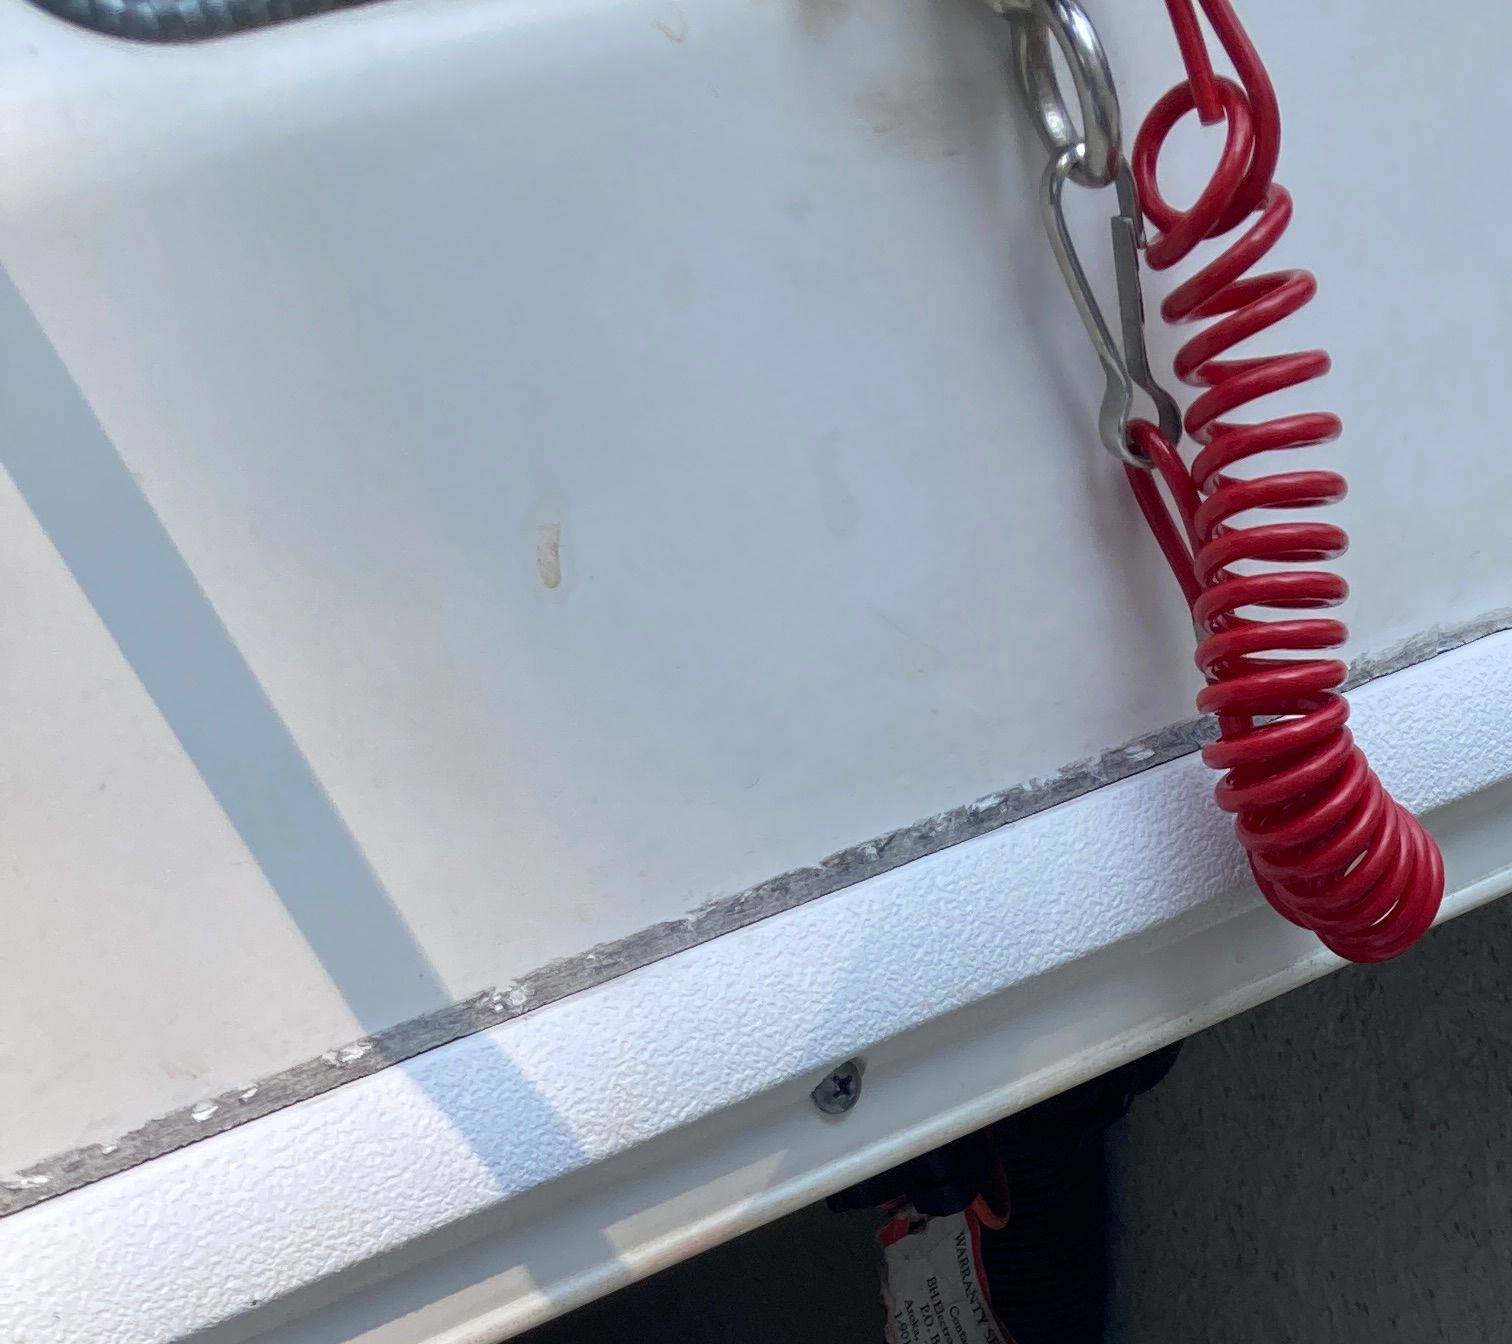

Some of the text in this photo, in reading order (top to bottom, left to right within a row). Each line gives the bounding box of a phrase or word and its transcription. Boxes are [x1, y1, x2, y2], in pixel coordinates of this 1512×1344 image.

[927, 1276, 940, 1300] BH
[954, 1231, 988, 1325] WARRANTY
[904, 1299, 920, 1342] Atoka,
[920, 1303, 934, 1332] P.O.
